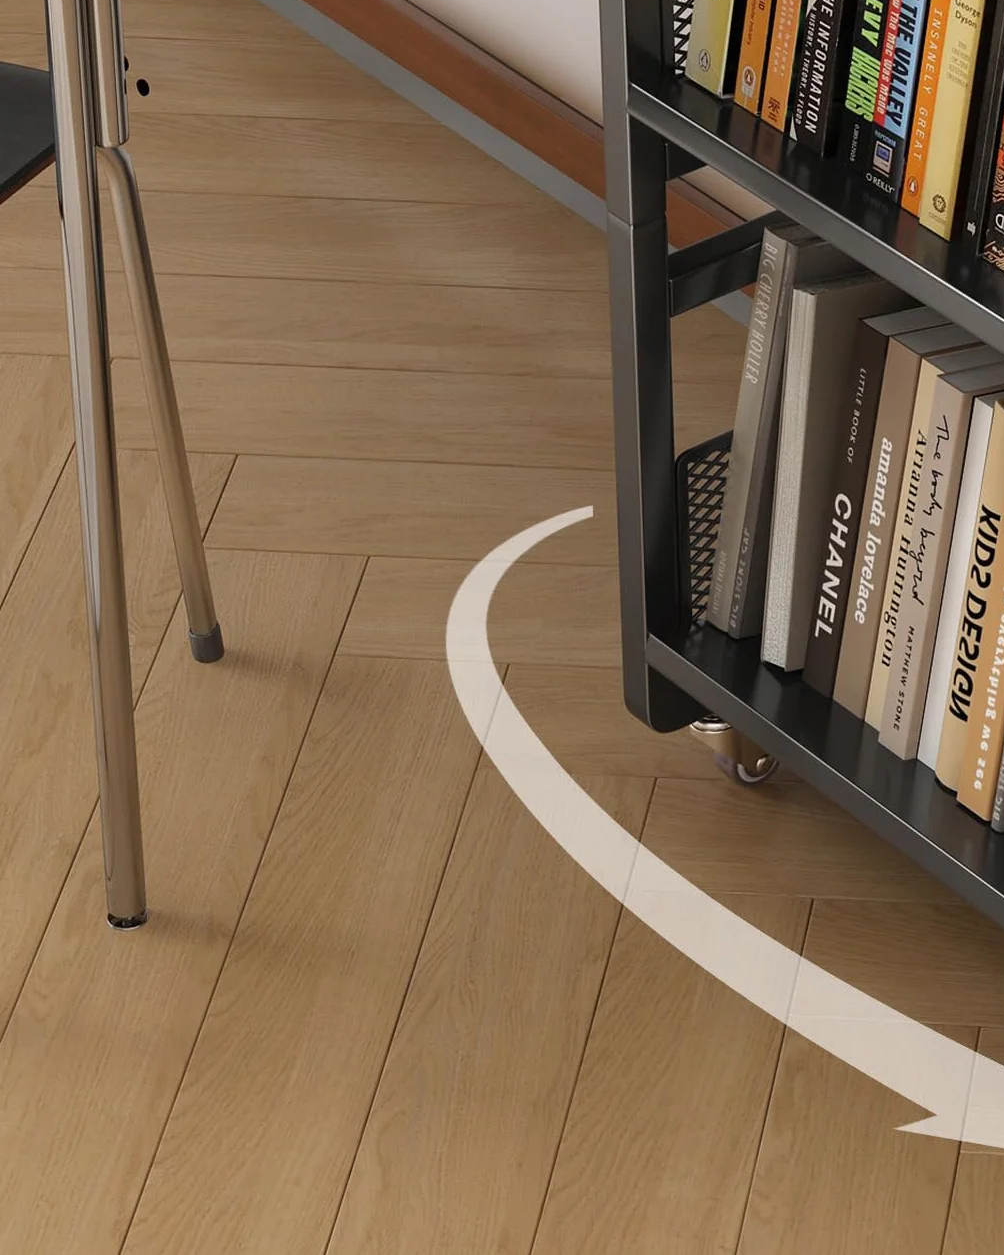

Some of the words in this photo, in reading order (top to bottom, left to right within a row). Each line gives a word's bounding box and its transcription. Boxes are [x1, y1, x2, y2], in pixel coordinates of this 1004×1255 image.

[888, 10, 900, 30] The
[895, 3, 918, 45] THE
[955, 10, 978, 29] Dyson
[804, 20, 832, 134] INFORMATION
[923, 8, 943, 95] INSANELY
[845, 46, 881, 123] HACKERS
[886, 47, 912, 127] VALLEY
[794, 101, 804, 126] FLOOD
[913, 106, 929, 161] GREAT
[762, 242, 778, 271] BIG
[754, 272, 774, 330] CHERRY
[745, 328, 765, 385] HOLLER
[855, 367, 867, 406] LITTLE
[849, 408, 861, 444] BOOK
[933, 415, 950, 460] The
[847, 447, 854, 465] OF
[869, 436, 893, 527] amanda
[904, 429, 927, 526] Arianna
[814, 492, 852, 638] CHANEL
[854, 531, 882, 625] lovelace
[900, 625, 915, 687] MATTHEW
[893, 691, 906, 732] STONE
[993, 796, 1003, 822] BIG
